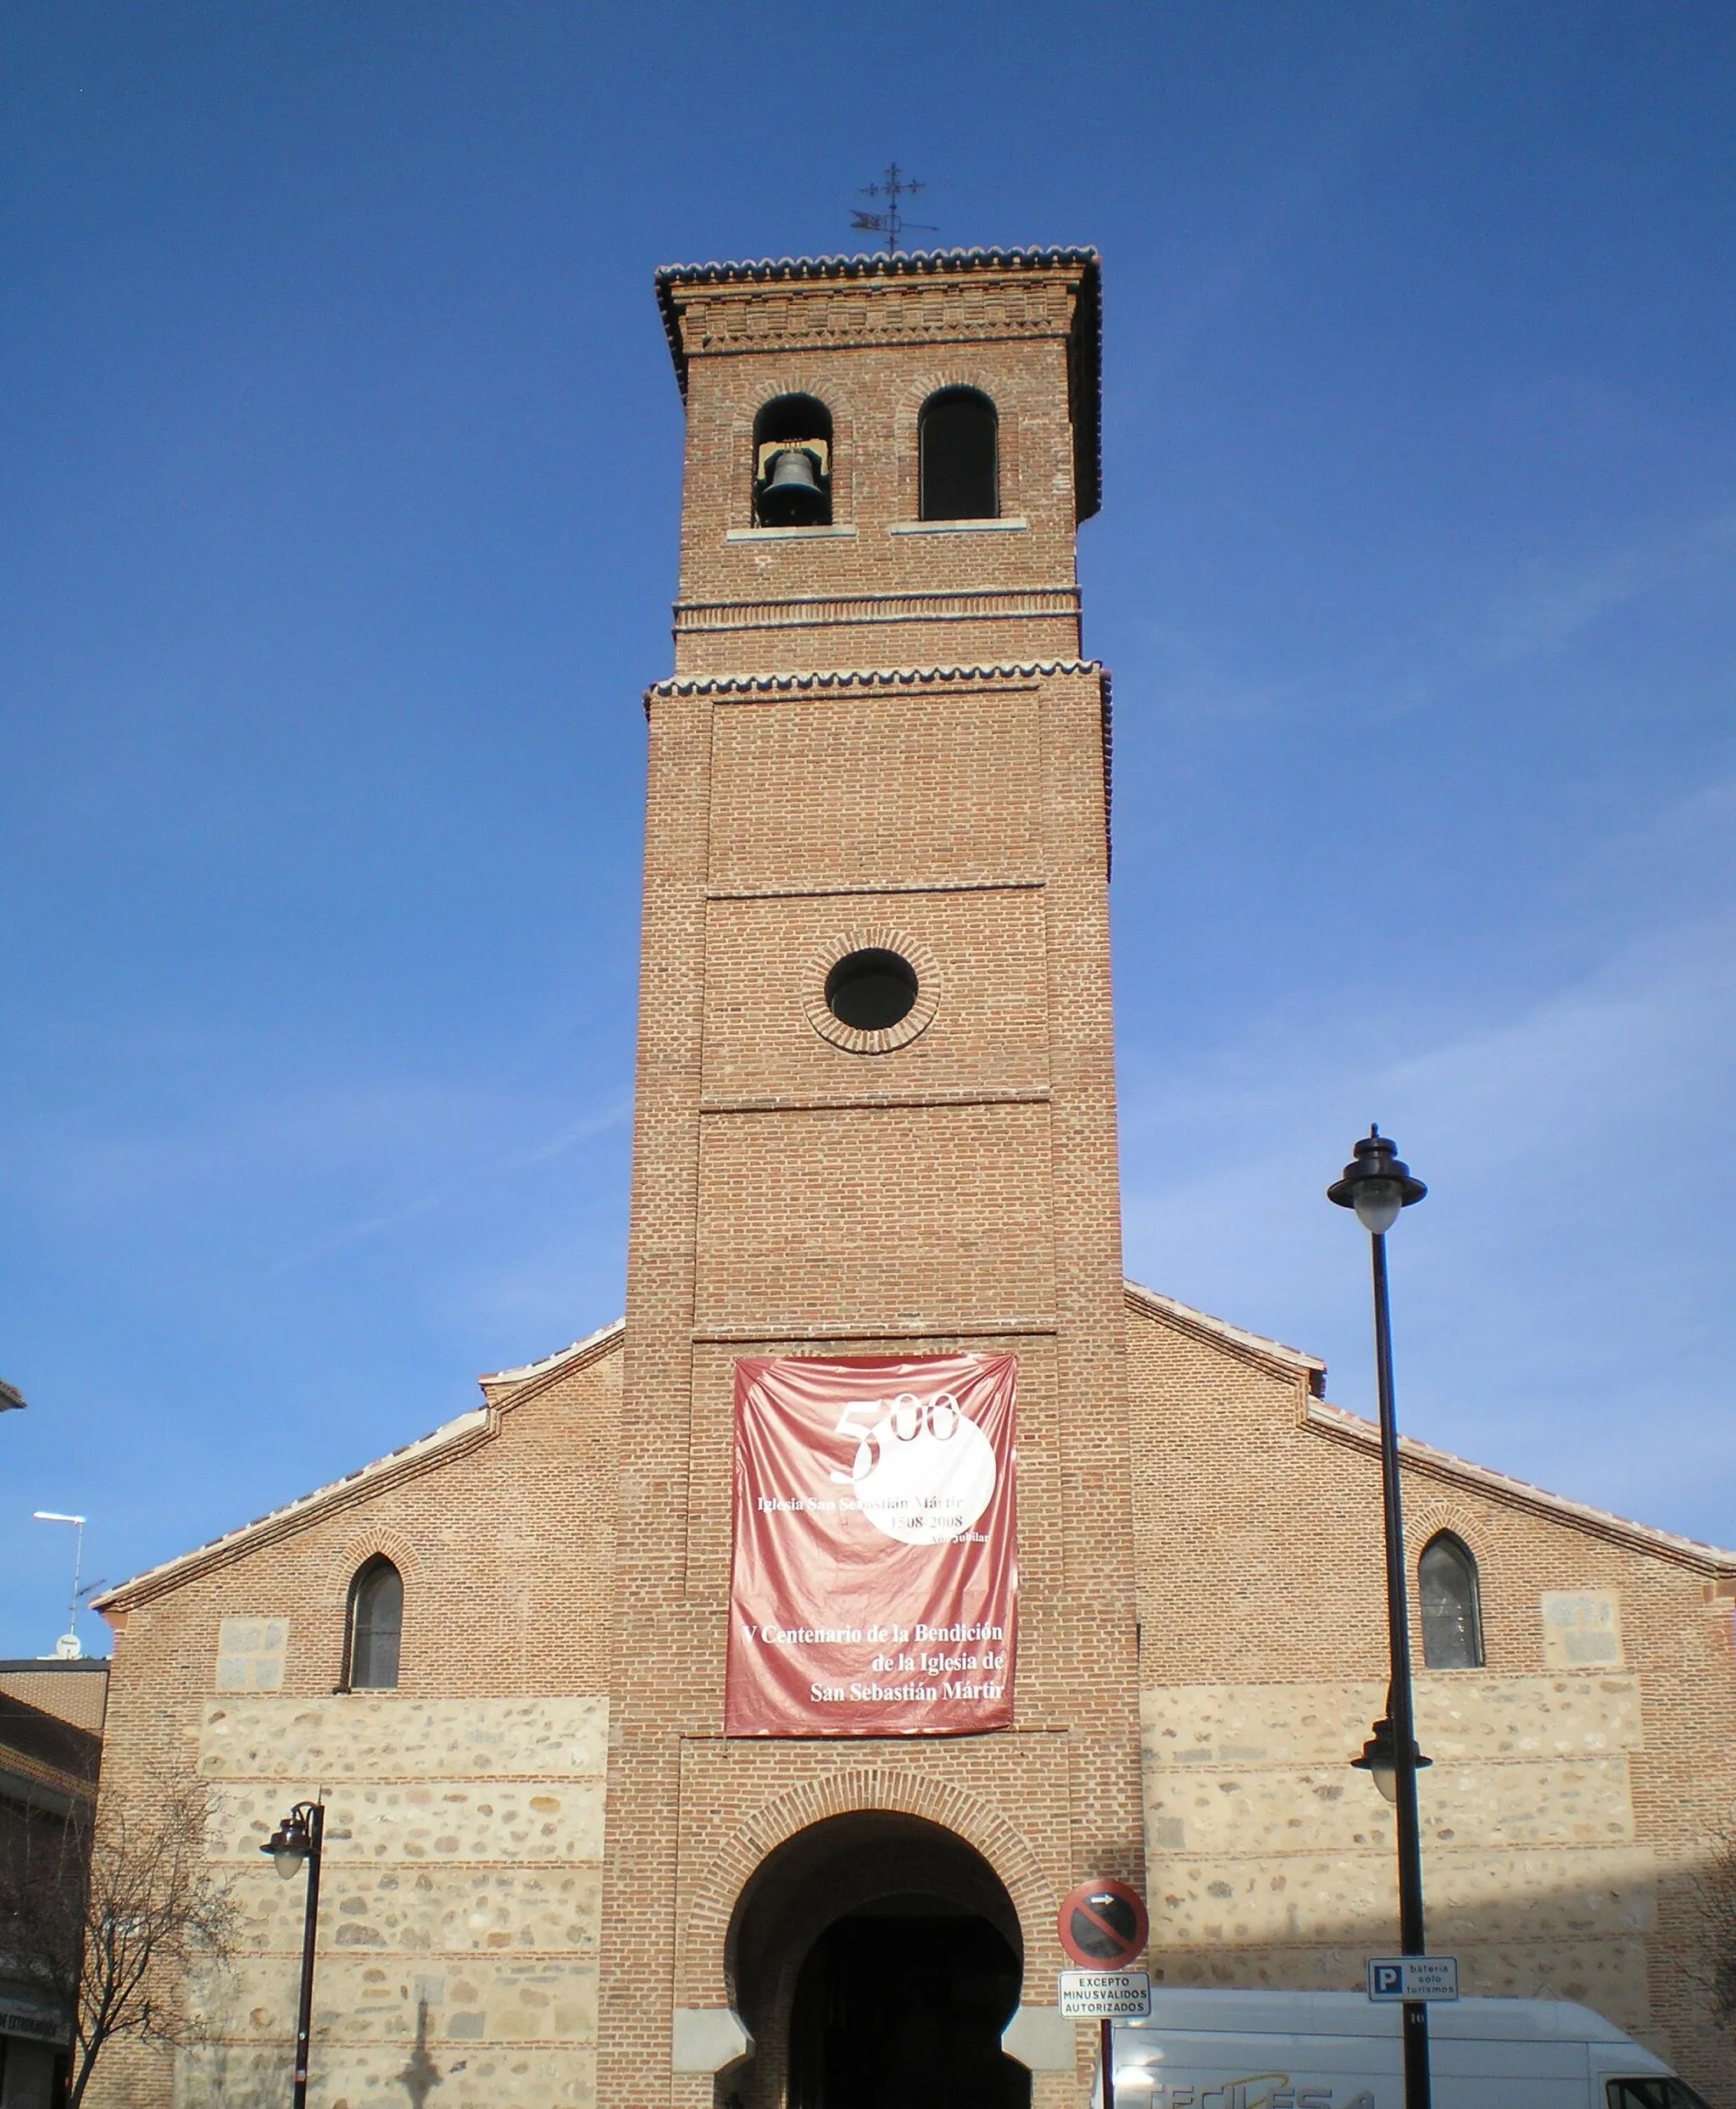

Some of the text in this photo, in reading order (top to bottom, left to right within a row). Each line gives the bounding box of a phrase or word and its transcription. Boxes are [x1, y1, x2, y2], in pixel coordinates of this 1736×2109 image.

[829, 1393, 960, 1484] 500
[757, 1497, 804, 1514] Iglesia
[806, 1497, 835, 1511] San
[743, 1621, 1003, 1644] V Centenario de la Bendición
[871, 1651, 1004, 1676] de la Iglesia de
[810, 1680, 1004, 1702] San Sebastián Mártir
[1079, 1977, 1129, 1987] EXCEPTO
[1407, 1985, 1455, 1994] turismos
[1063, 1989, 1147, 2000] MINUSVALIDOS
[1066, 2002, 1144, 2012] AUTORIZADOS
